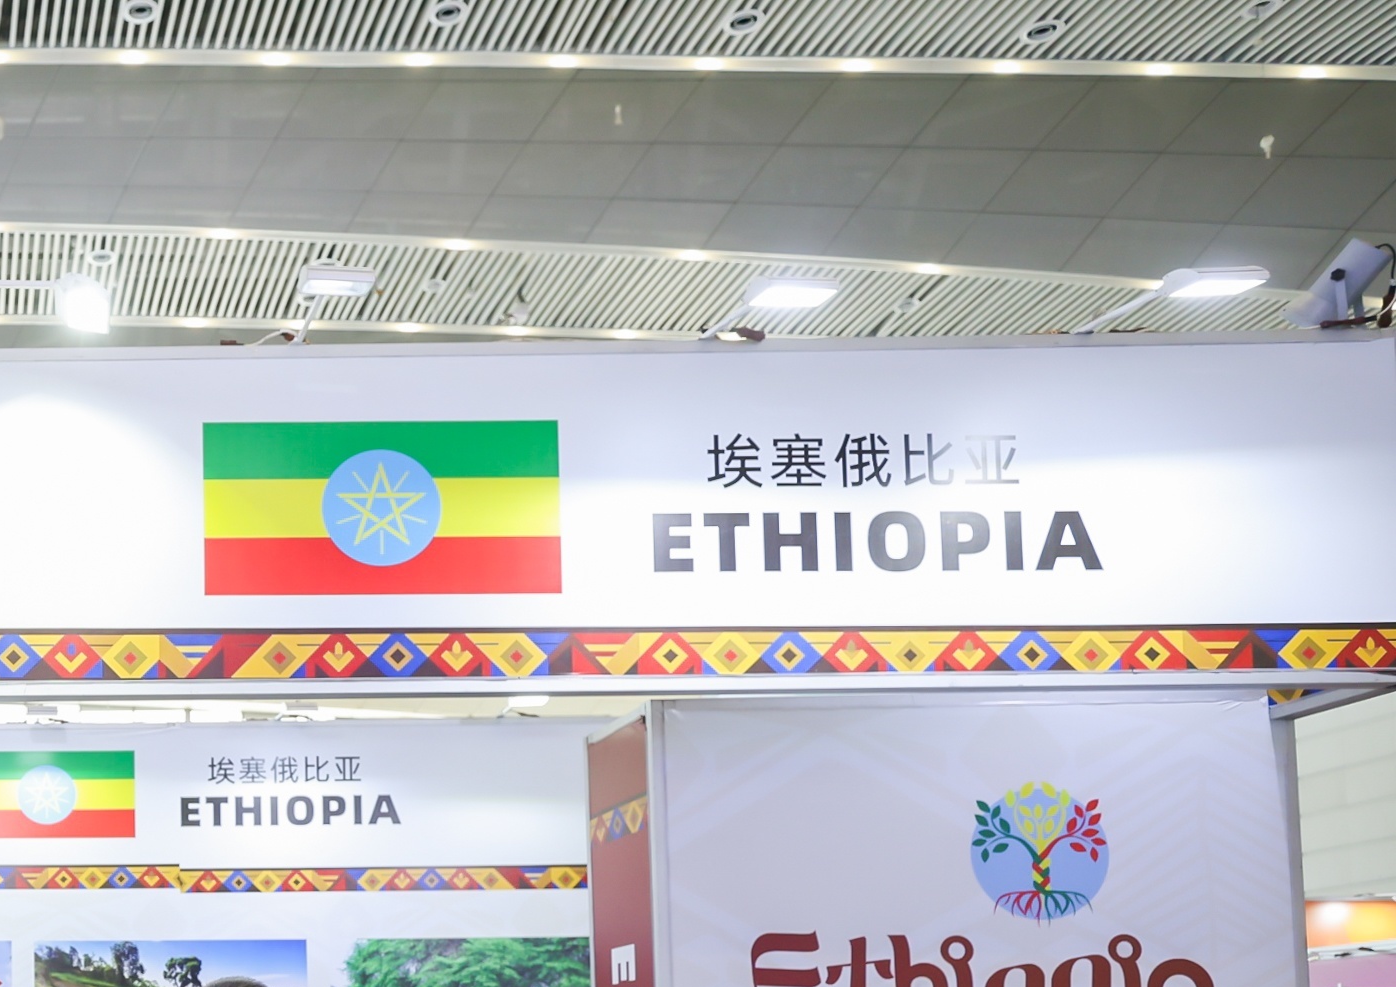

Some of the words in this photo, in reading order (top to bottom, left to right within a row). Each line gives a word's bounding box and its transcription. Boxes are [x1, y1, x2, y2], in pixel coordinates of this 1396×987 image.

[706, 432, 1020, 488] 埃塞俄比亚
[652, 510, 1104, 572] ETHIOPIA
[207, 756, 362, 784] 埃塞俄比亚
[180, 794, 402, 827] ETHIOPIA
